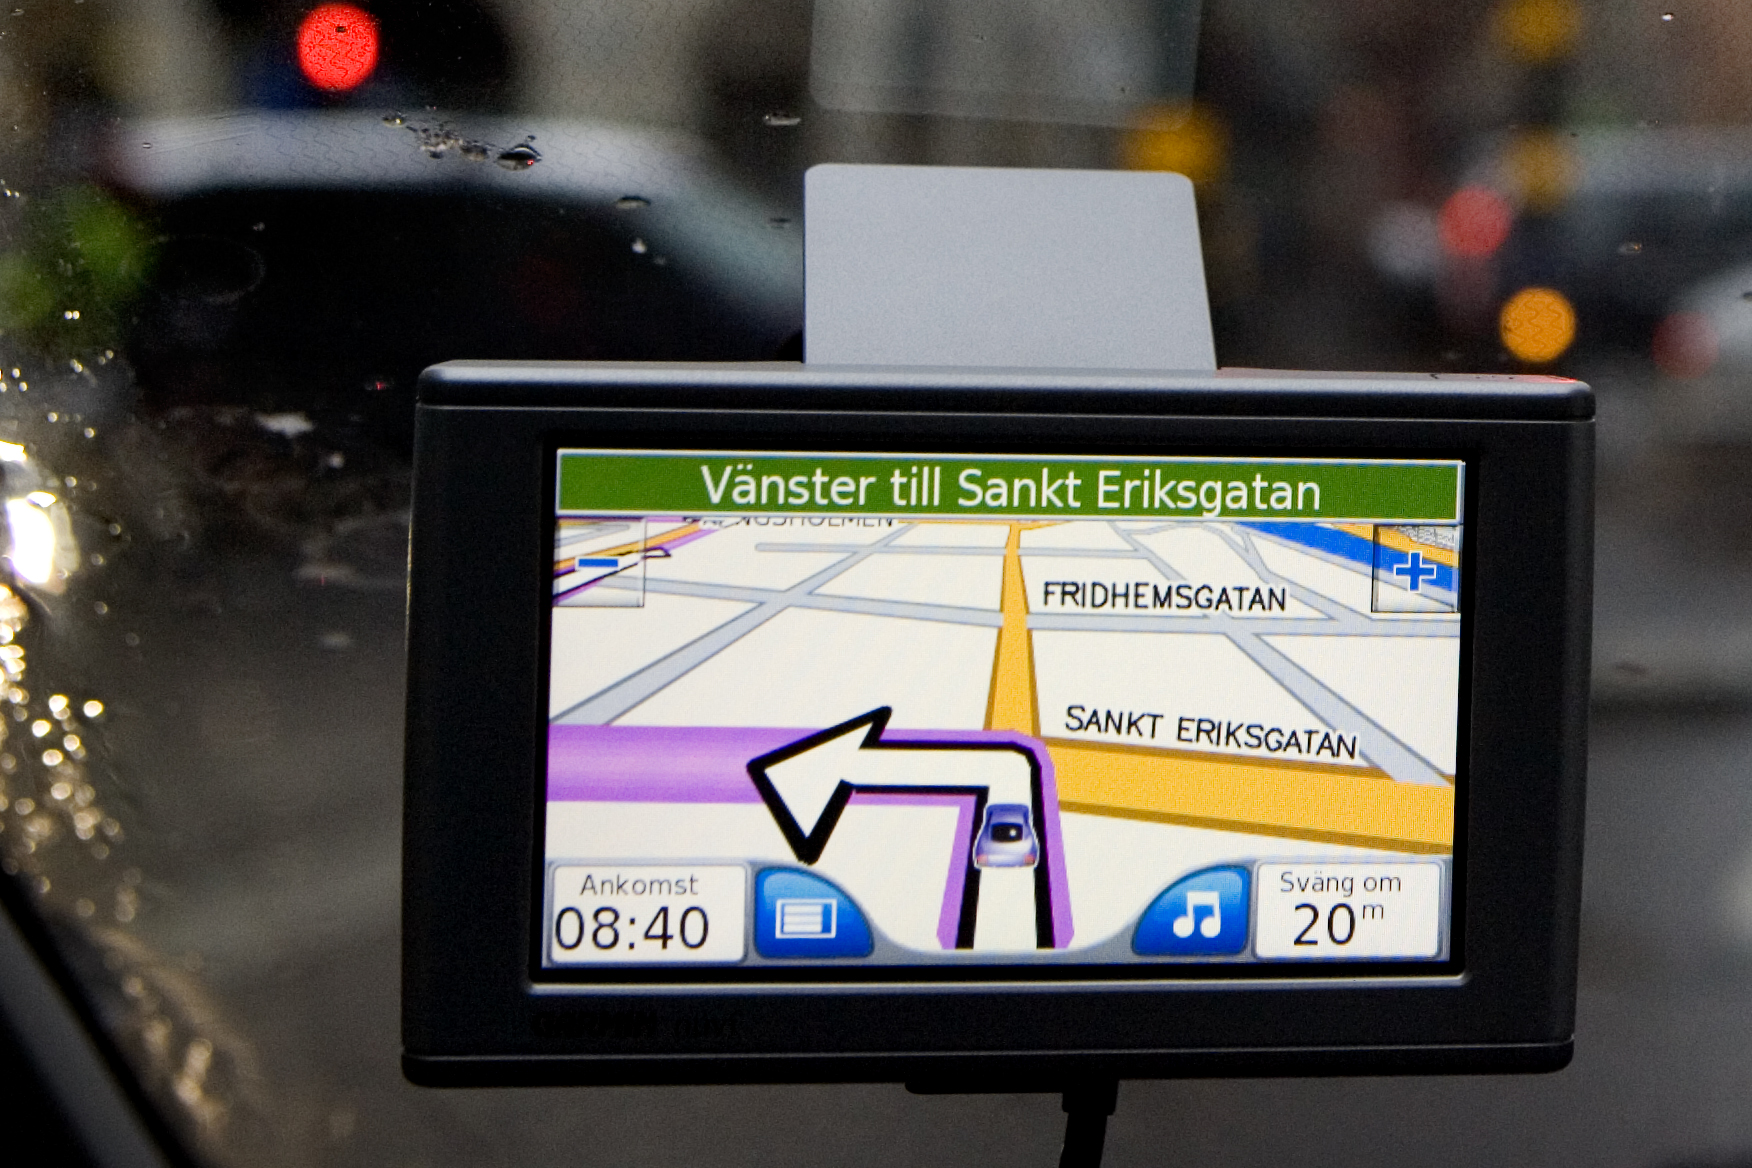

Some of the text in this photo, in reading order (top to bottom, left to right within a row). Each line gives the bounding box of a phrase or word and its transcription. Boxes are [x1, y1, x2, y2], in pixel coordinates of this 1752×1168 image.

[700, 463, 1321, 517] Vänster till Sankt Eriksgatan
[1043, 580, 1287, 612] FRIDHEMSGATAN
[1064, 704, 1358, 760] SANKT ERIKSGATAN
[580, 874, 699, 896] Ankomst
[1280, 871, 1402, 898] Sväng om
[554, 905, 710, 951] 08:40
